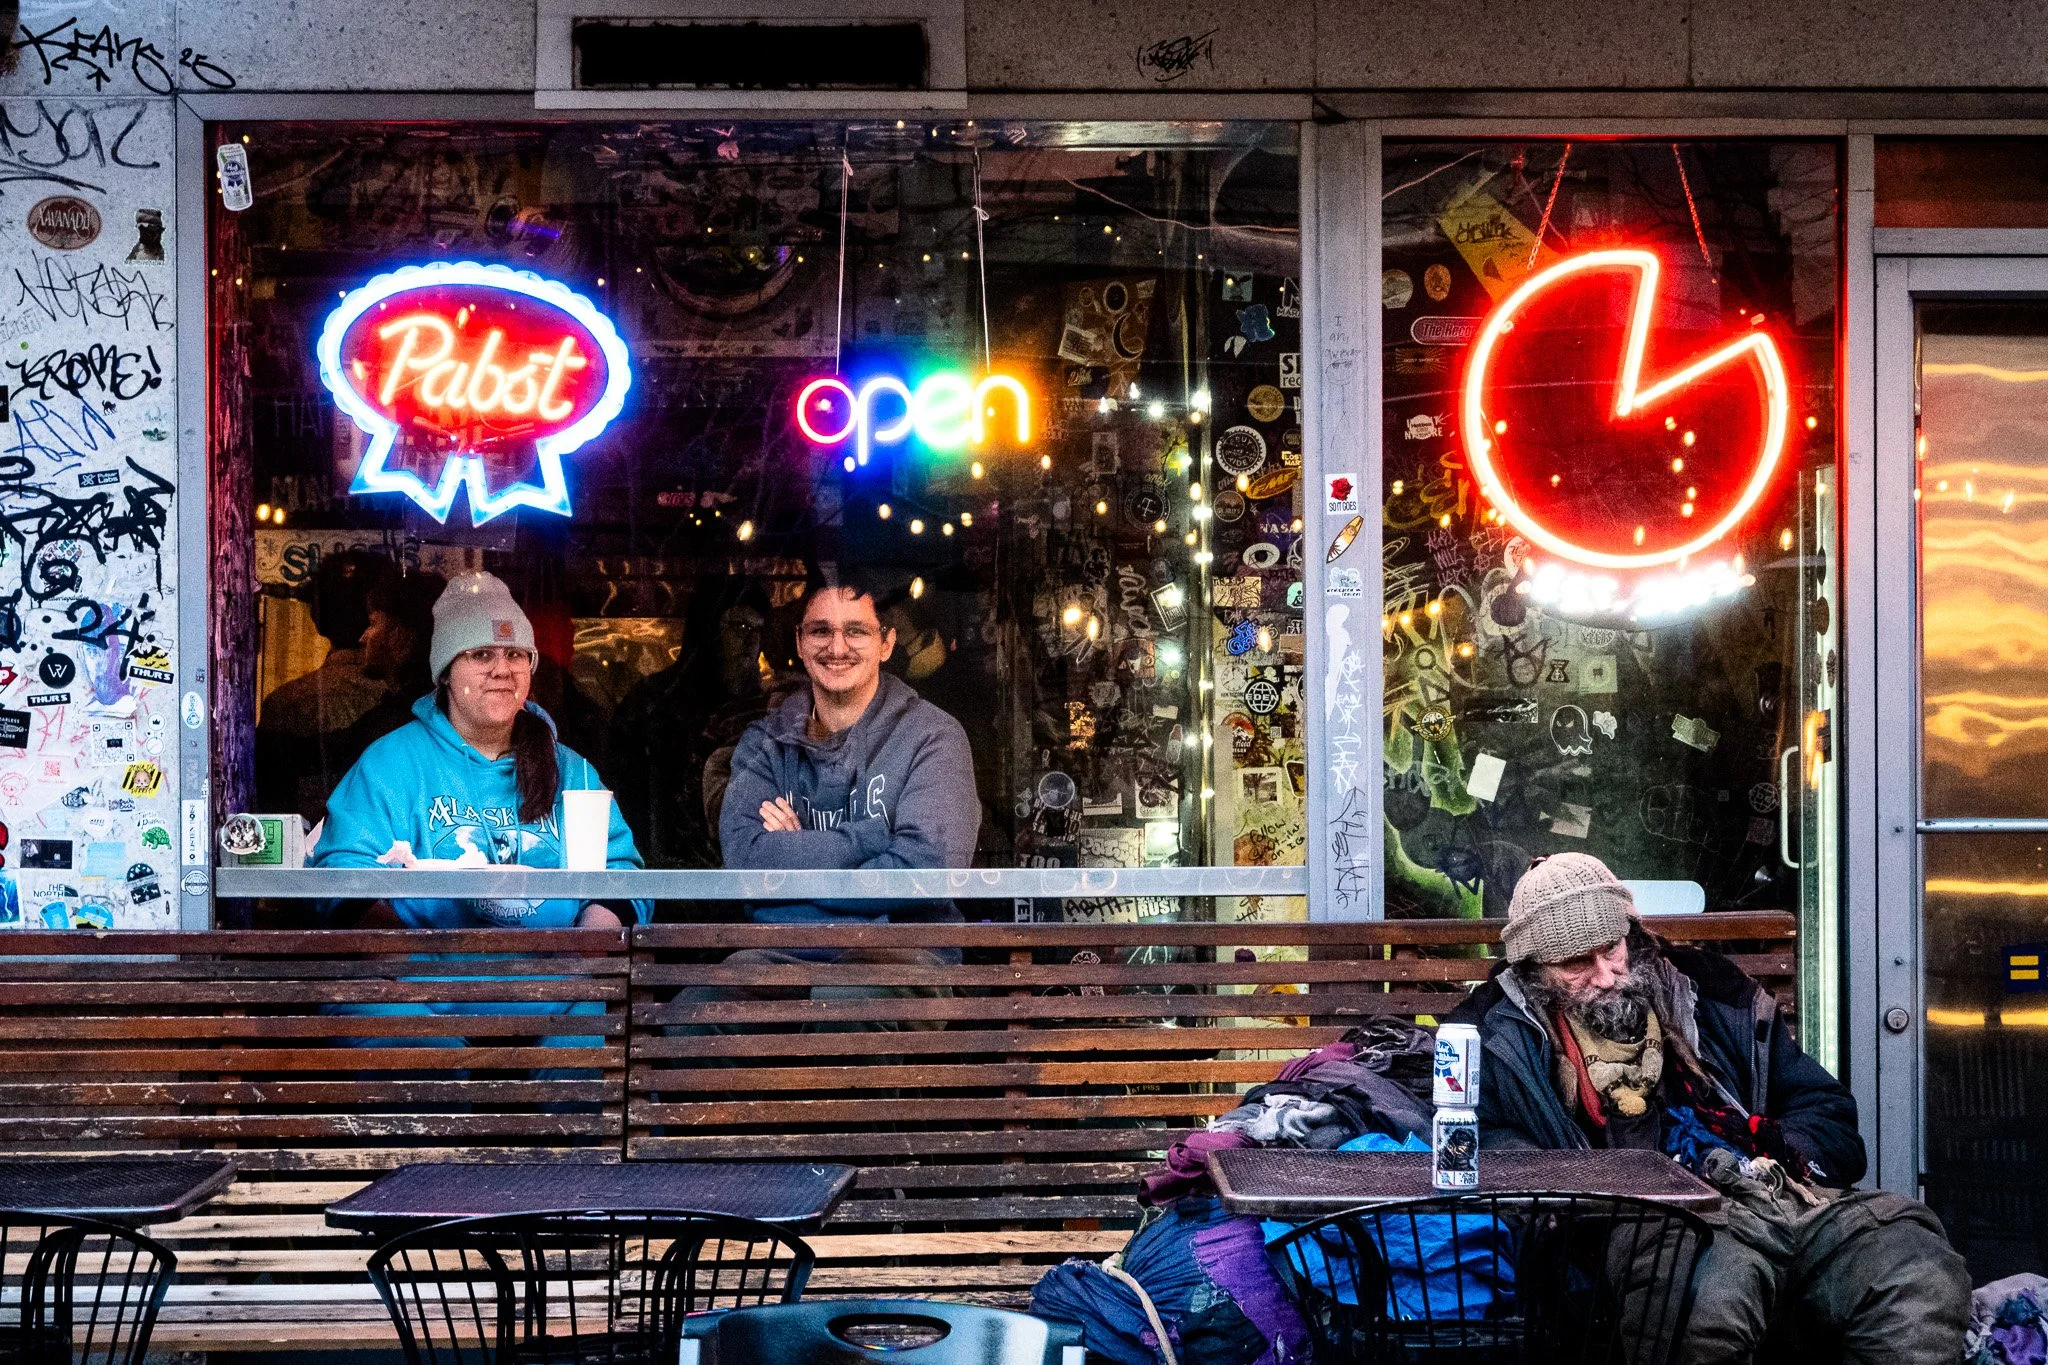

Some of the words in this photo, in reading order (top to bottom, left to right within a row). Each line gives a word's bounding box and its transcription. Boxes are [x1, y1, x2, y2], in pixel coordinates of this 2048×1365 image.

[379, 315, 587, 421] Pabst
[797, 373, 1031, 466] open
[98, 476, 119, 484] Labs
[1329, 502, 1336, 511] SO
[1343, 501, 1357, 511] GOES
[429, 795, 560, 841] ALASKN
[1138, 898, 1181, 918] RUSK
